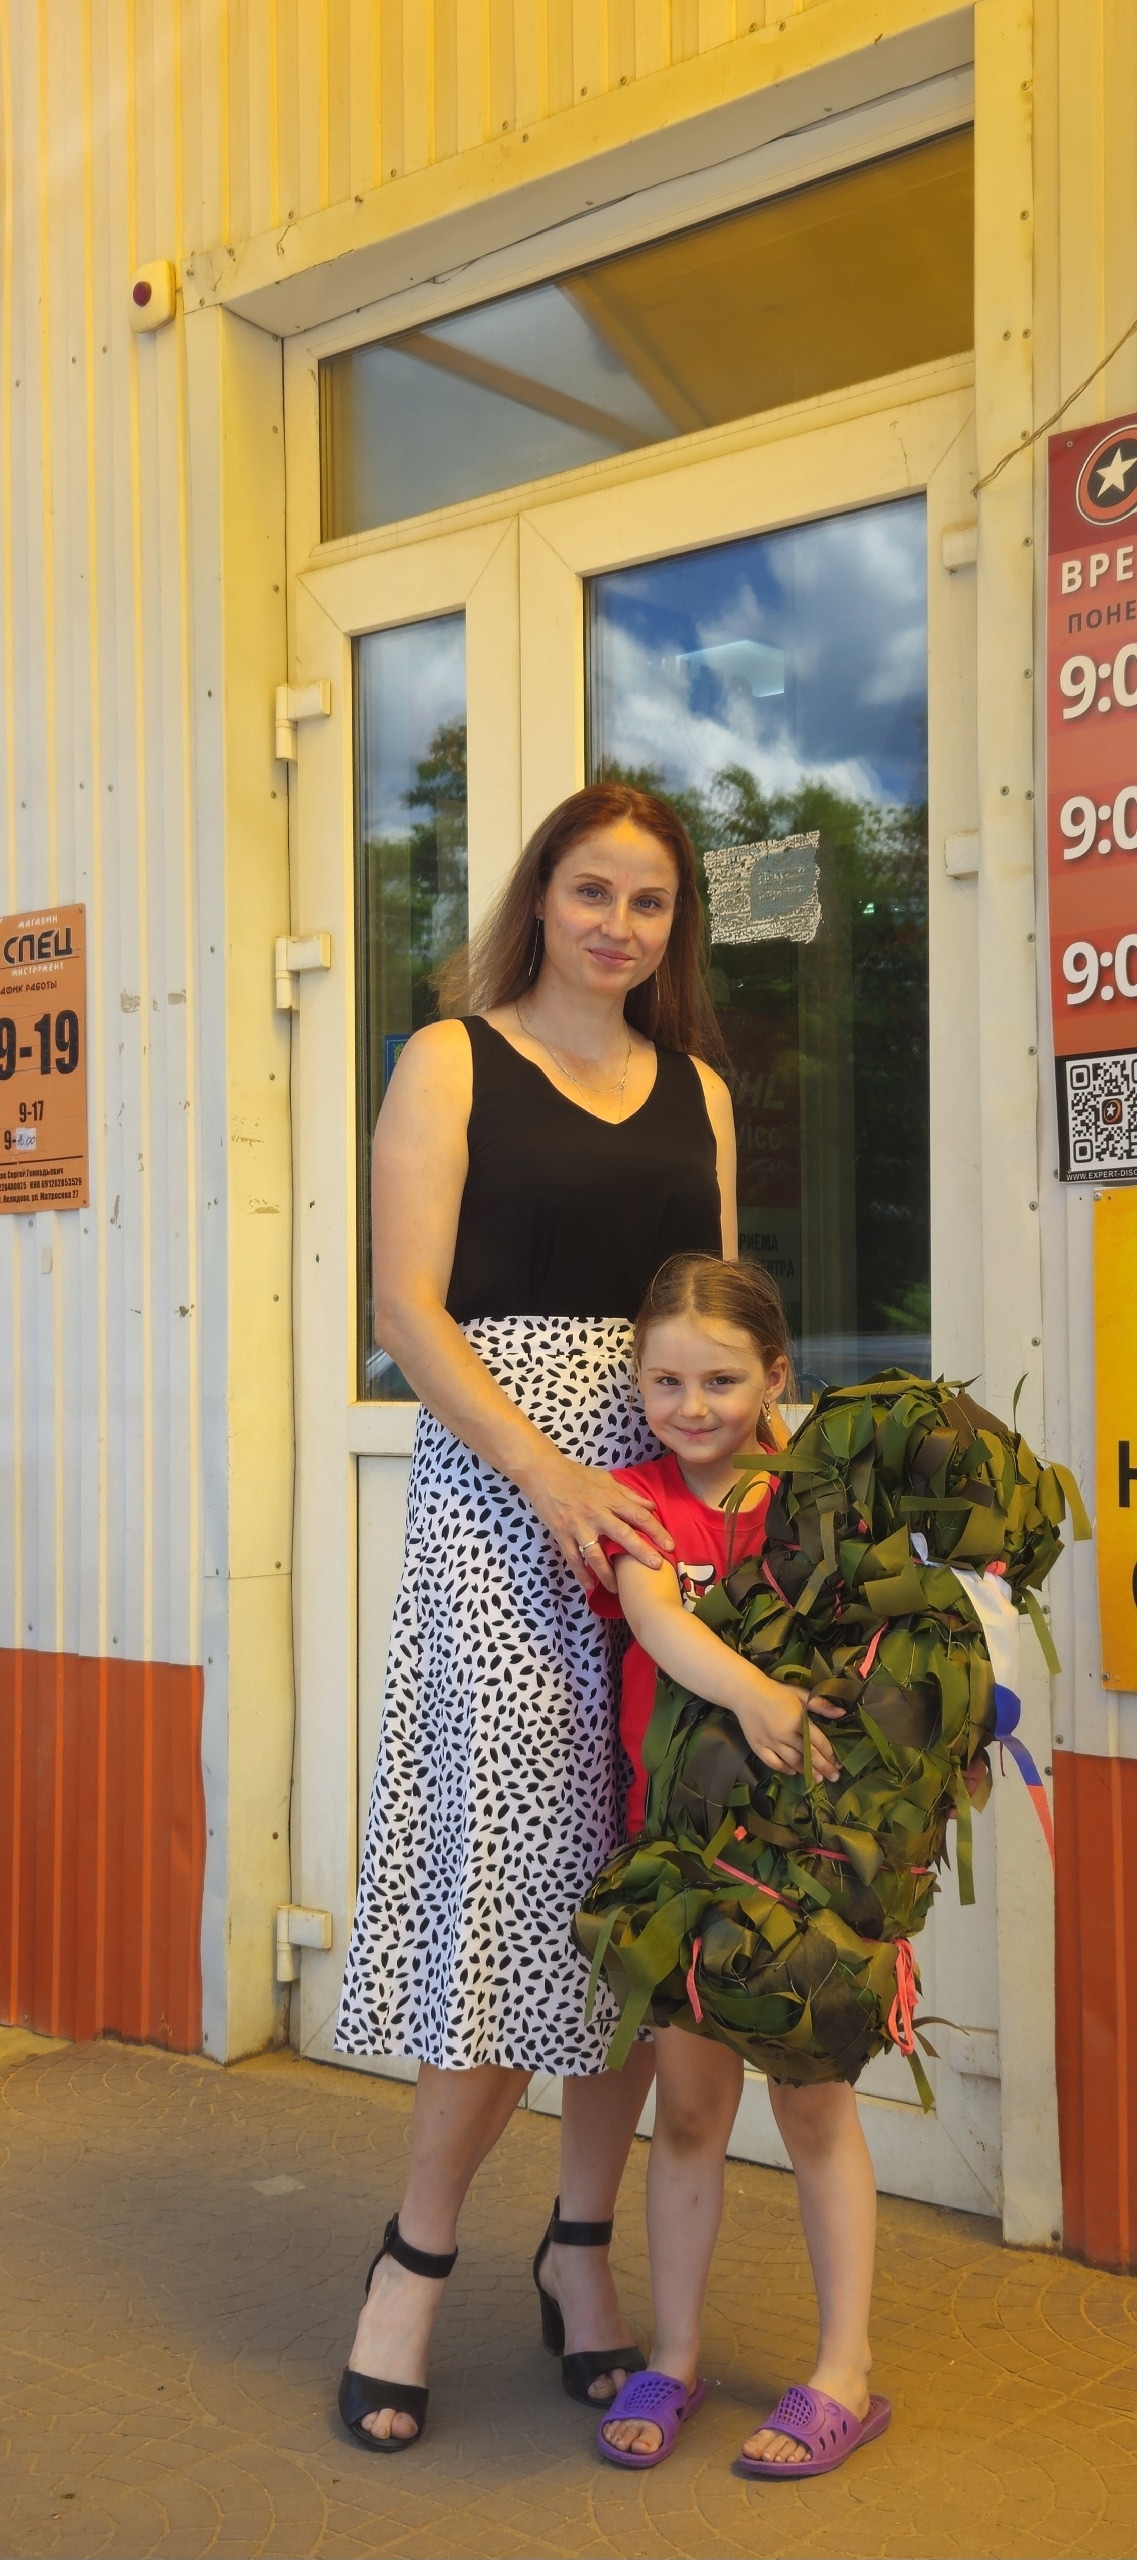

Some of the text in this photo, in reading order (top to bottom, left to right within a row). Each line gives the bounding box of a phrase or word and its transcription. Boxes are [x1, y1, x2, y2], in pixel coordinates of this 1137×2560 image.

[1061, 545, 1134, 595] ВРЕ
[1068, 599, 1137, 634] ПОНЕ
[18, 915, 58, 928] МАГАЗИН
[4, 927, 73, 964] СПЕЦ
[12, 962, 64, 977] ИНСТРУМЕНТ
[25, 980, 58, 992] РАБОТЫ
[19, 1100, 44, 1123] 9-17
[72, 1189, 79, 1198] 27
